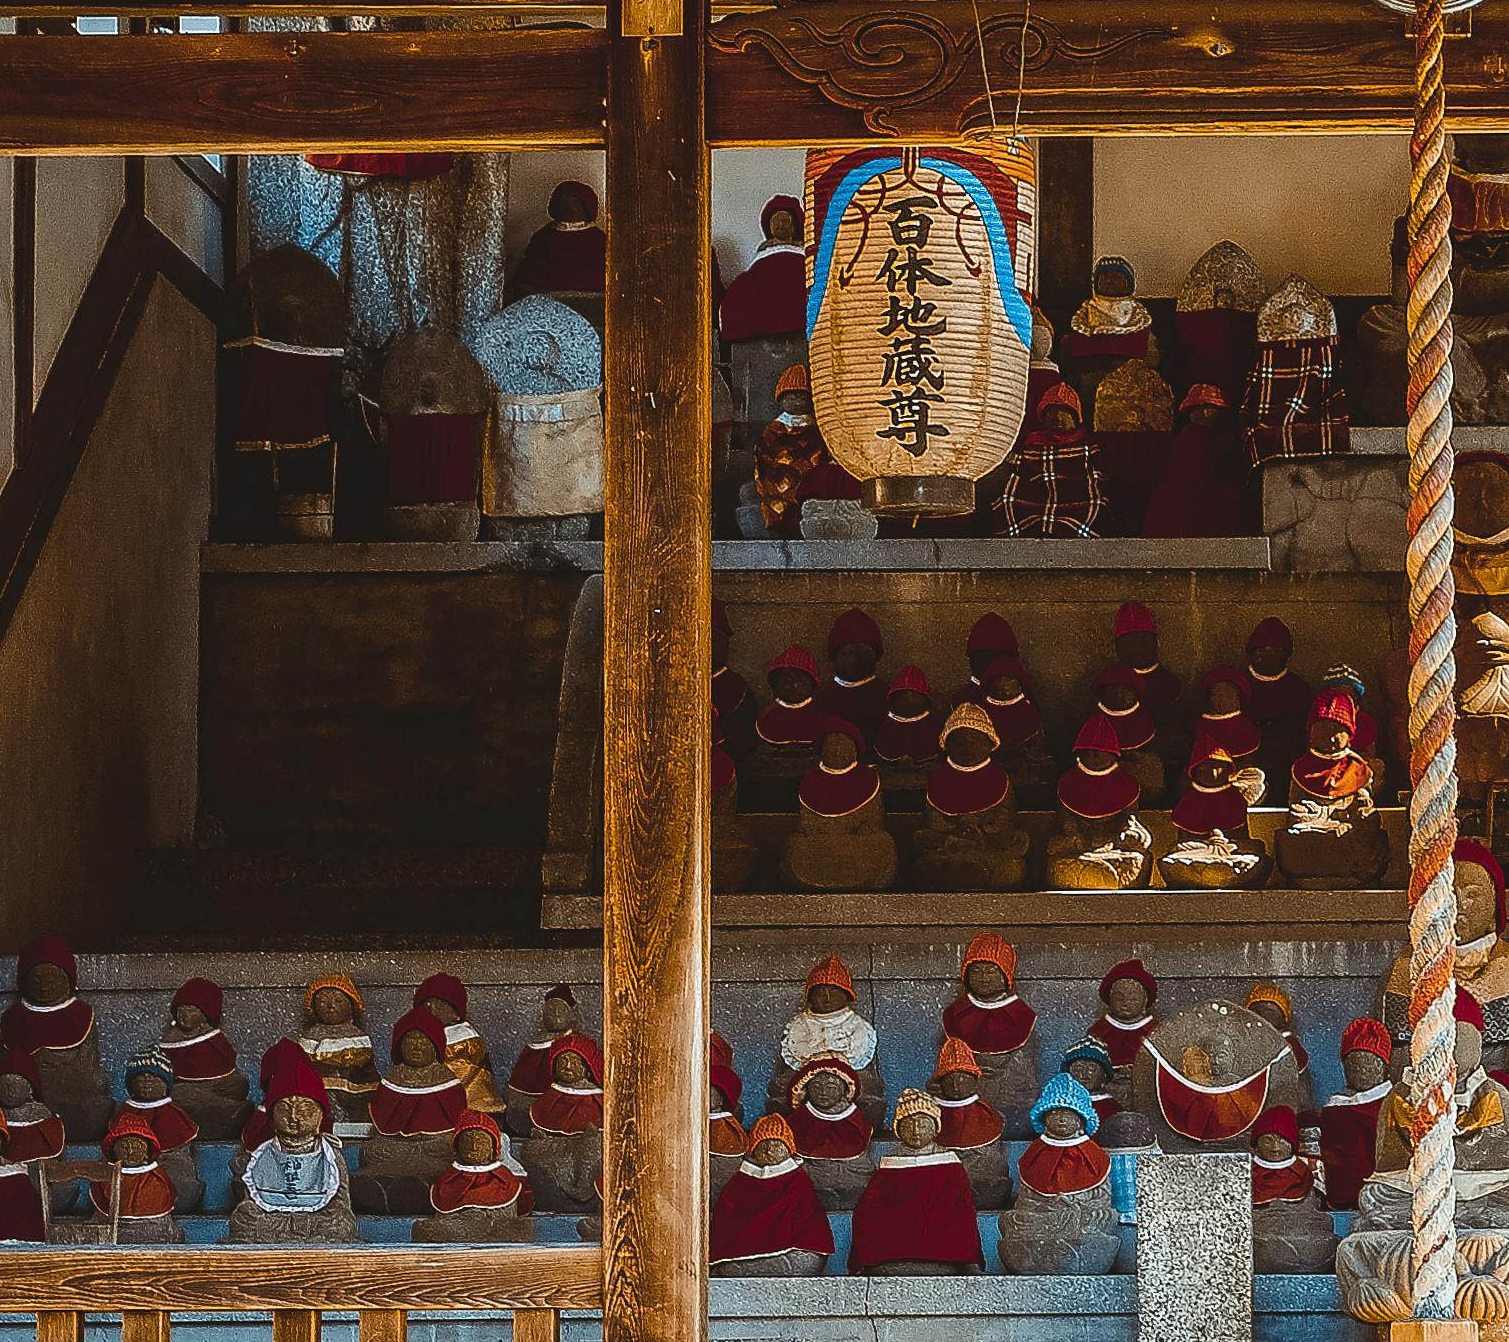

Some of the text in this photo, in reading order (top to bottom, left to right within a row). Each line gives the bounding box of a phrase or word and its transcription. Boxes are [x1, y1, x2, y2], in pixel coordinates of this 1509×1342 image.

[875, 194, 953, 458] 百体地蔵尊
